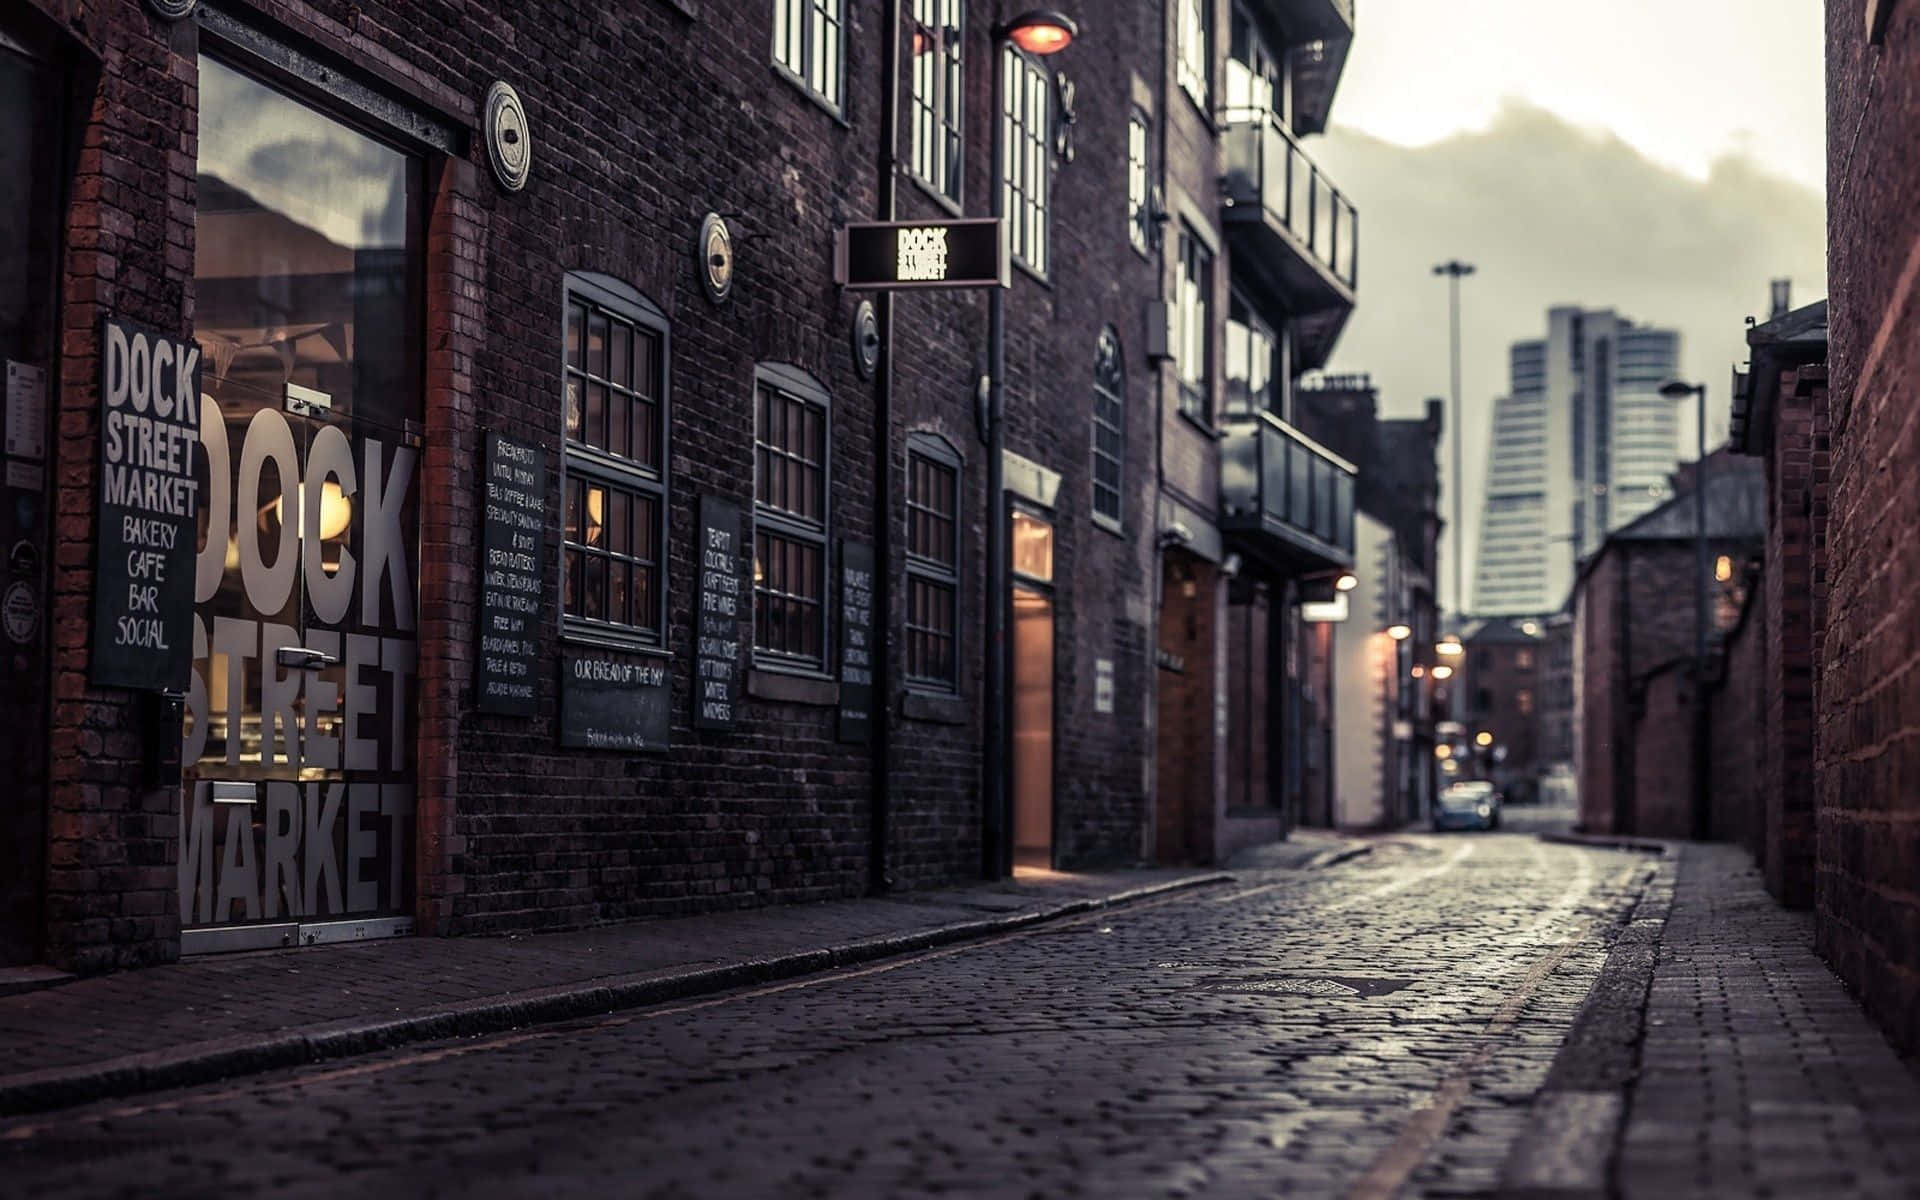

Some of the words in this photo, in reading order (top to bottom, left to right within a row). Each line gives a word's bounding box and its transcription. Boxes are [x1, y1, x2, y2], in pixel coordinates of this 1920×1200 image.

[897, 227, 948, 252] DOCK
[105, 322, 200, 425] DOCK
[105, 410, 199, 478] STREET
[104, 462, 199, 519] MARKET
[194, 392, 418, 633] DOCK
[122, 514, 178, 550] BAKERY
[127, 550, 166, 583] CAFE
[128, 583, 160, 614] BAR
[114, 615, 169, 650] SOCIAL
[493, 615, 510, 631] FREE
[574, 658, 593, 681] OUR
[593, 659, 621, 682] BREAD
[621, 663, 633, 683] OF
[633, 665, 650, 685] THE
[650, 667, 665, 688] DAY
[177, 780, 416, 926] MARKET
